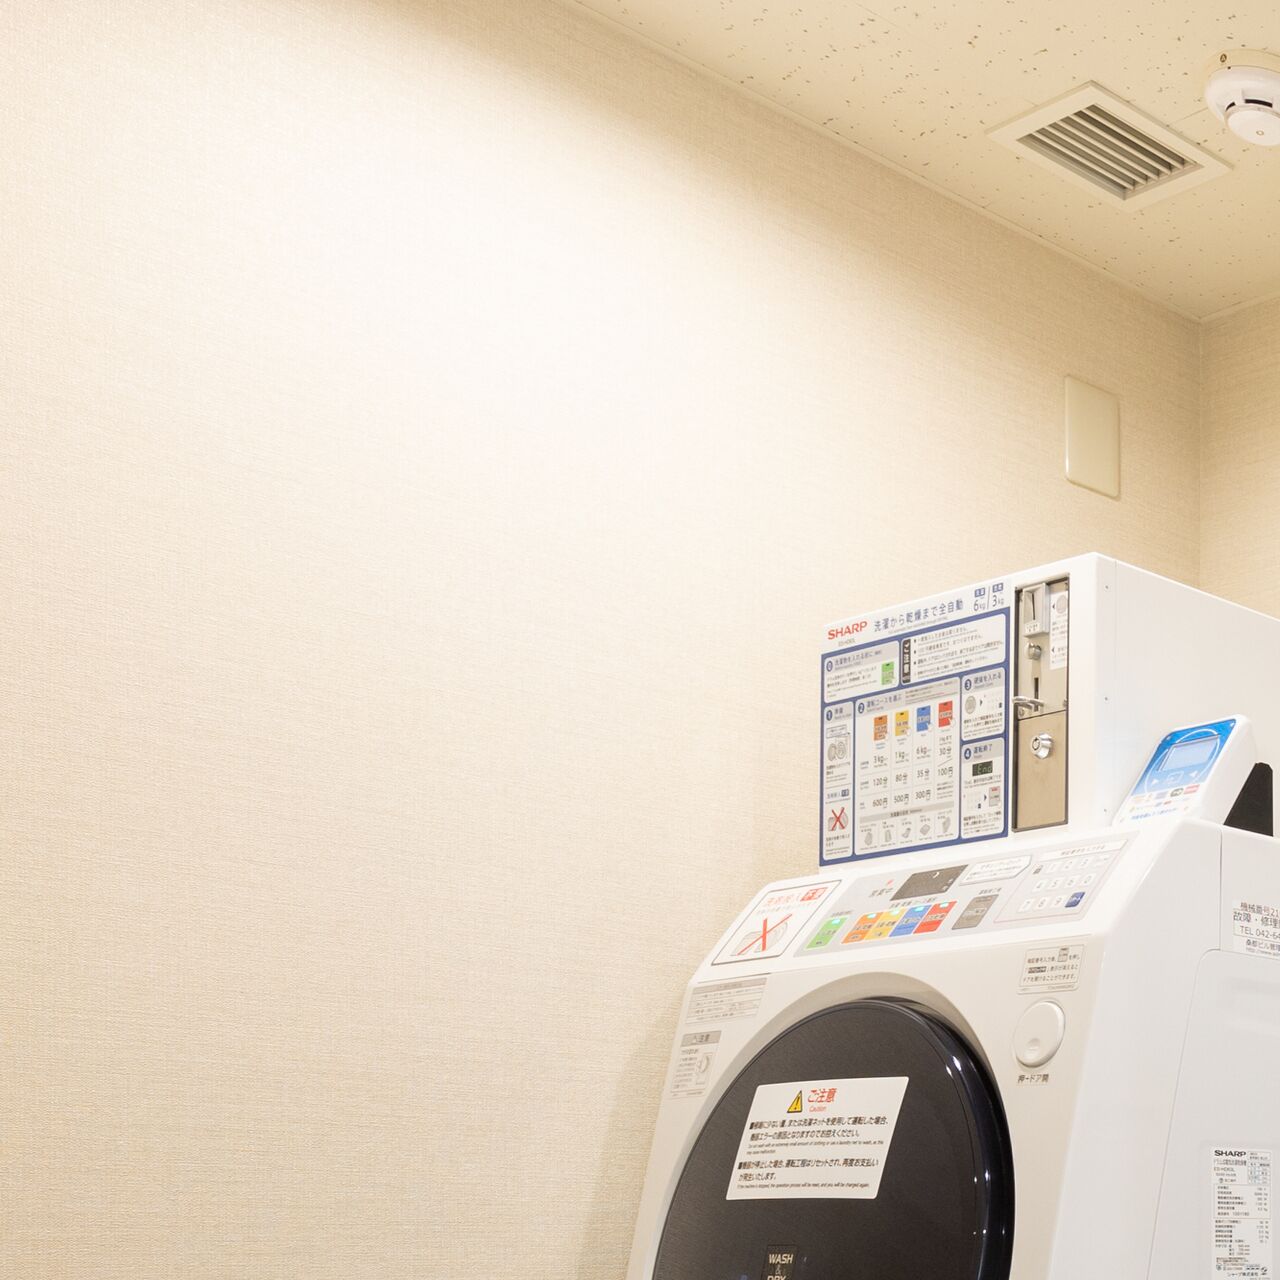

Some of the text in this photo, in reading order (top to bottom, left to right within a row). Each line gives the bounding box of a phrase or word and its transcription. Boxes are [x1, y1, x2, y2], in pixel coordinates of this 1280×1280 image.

[873, 599, 965, 633] 洗濯から乾燥まで全自動
[827, 620, 868, 640] SHARP
[1239, 925, 1254, 936] TEL
[807, 1088, 837, 1103] ご注意
[1214, 1149, 1247, 1157] SHARP
[768, 1254, 794, 1264] WASH
